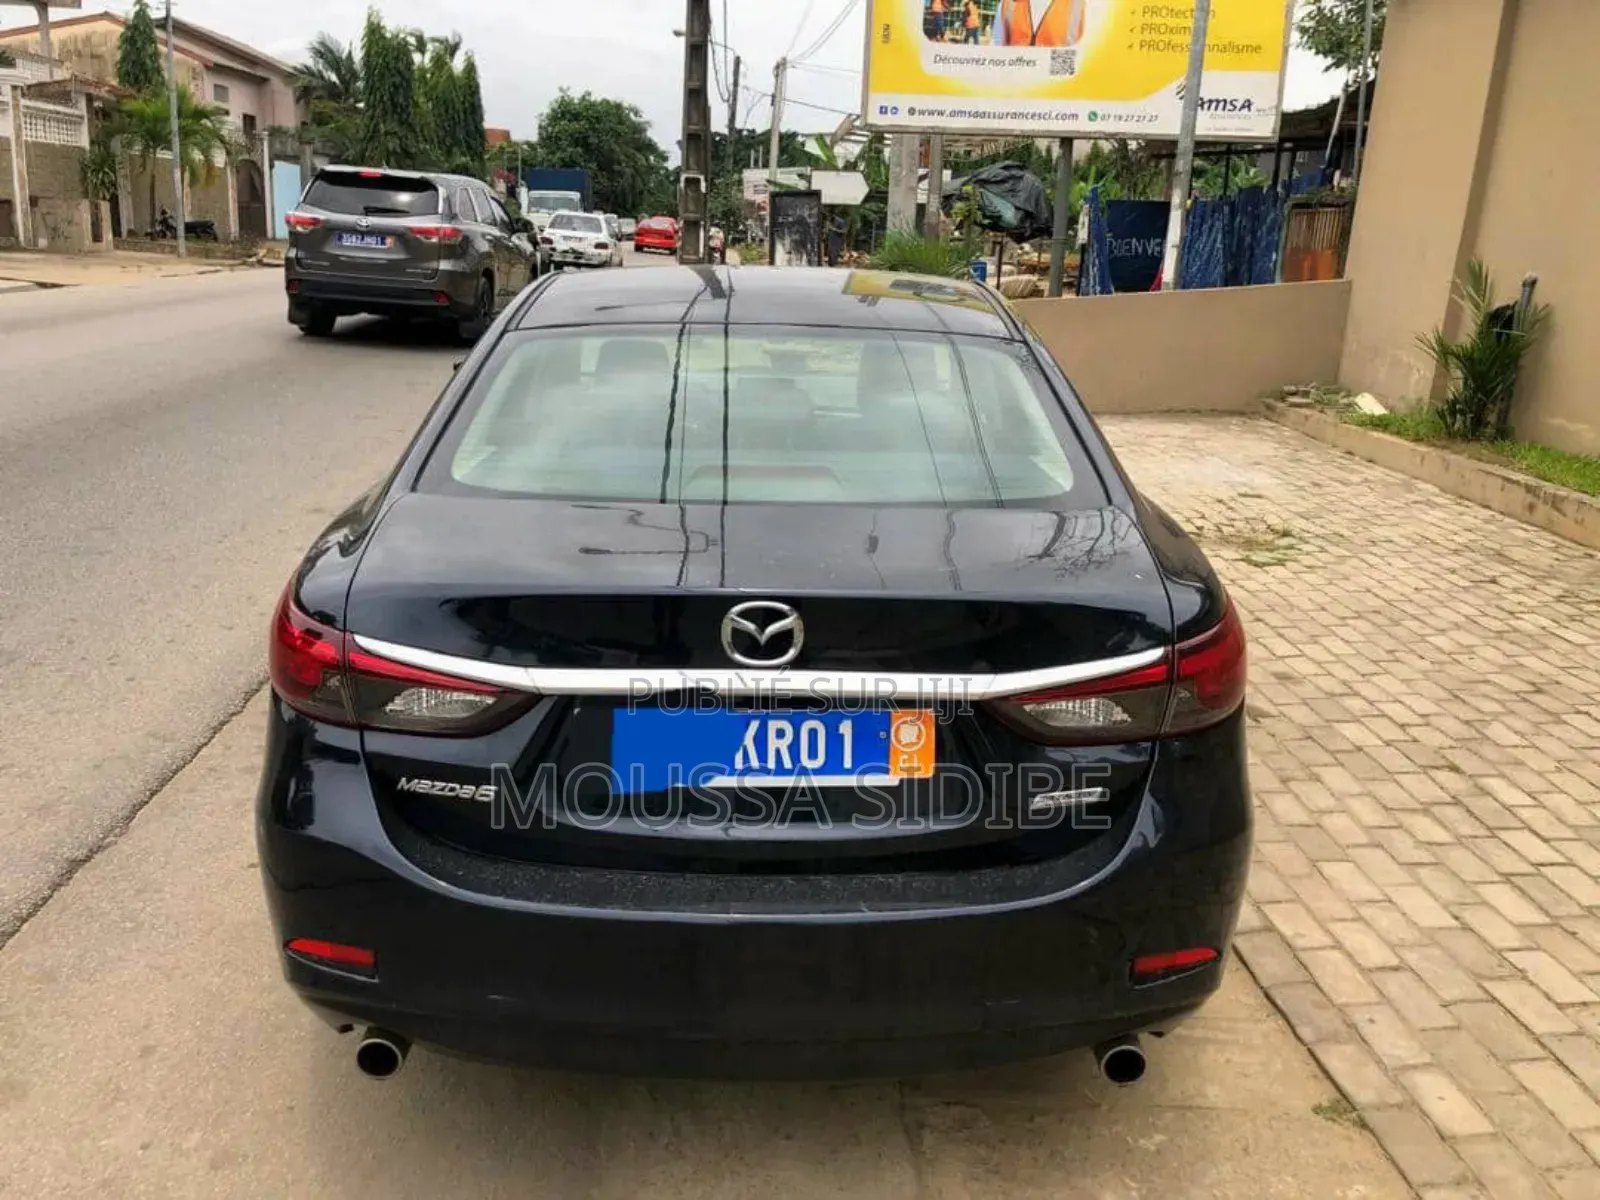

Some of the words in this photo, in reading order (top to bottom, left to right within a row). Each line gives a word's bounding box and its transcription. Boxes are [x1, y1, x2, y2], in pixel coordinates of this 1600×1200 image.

[1142, 5, 1216, 19] PROtectn
[1140, 23, 1192, 35] PROxim
[1139, 39, 1263, 54] PROfessnnalisme
[932, 53, 985, 66] Découvrez
[988, 57, 1006, 67] nos
[1008, 55, 1037, 67] offres
[917, 107, 1079, 121] www.amsaassurancesci.com
